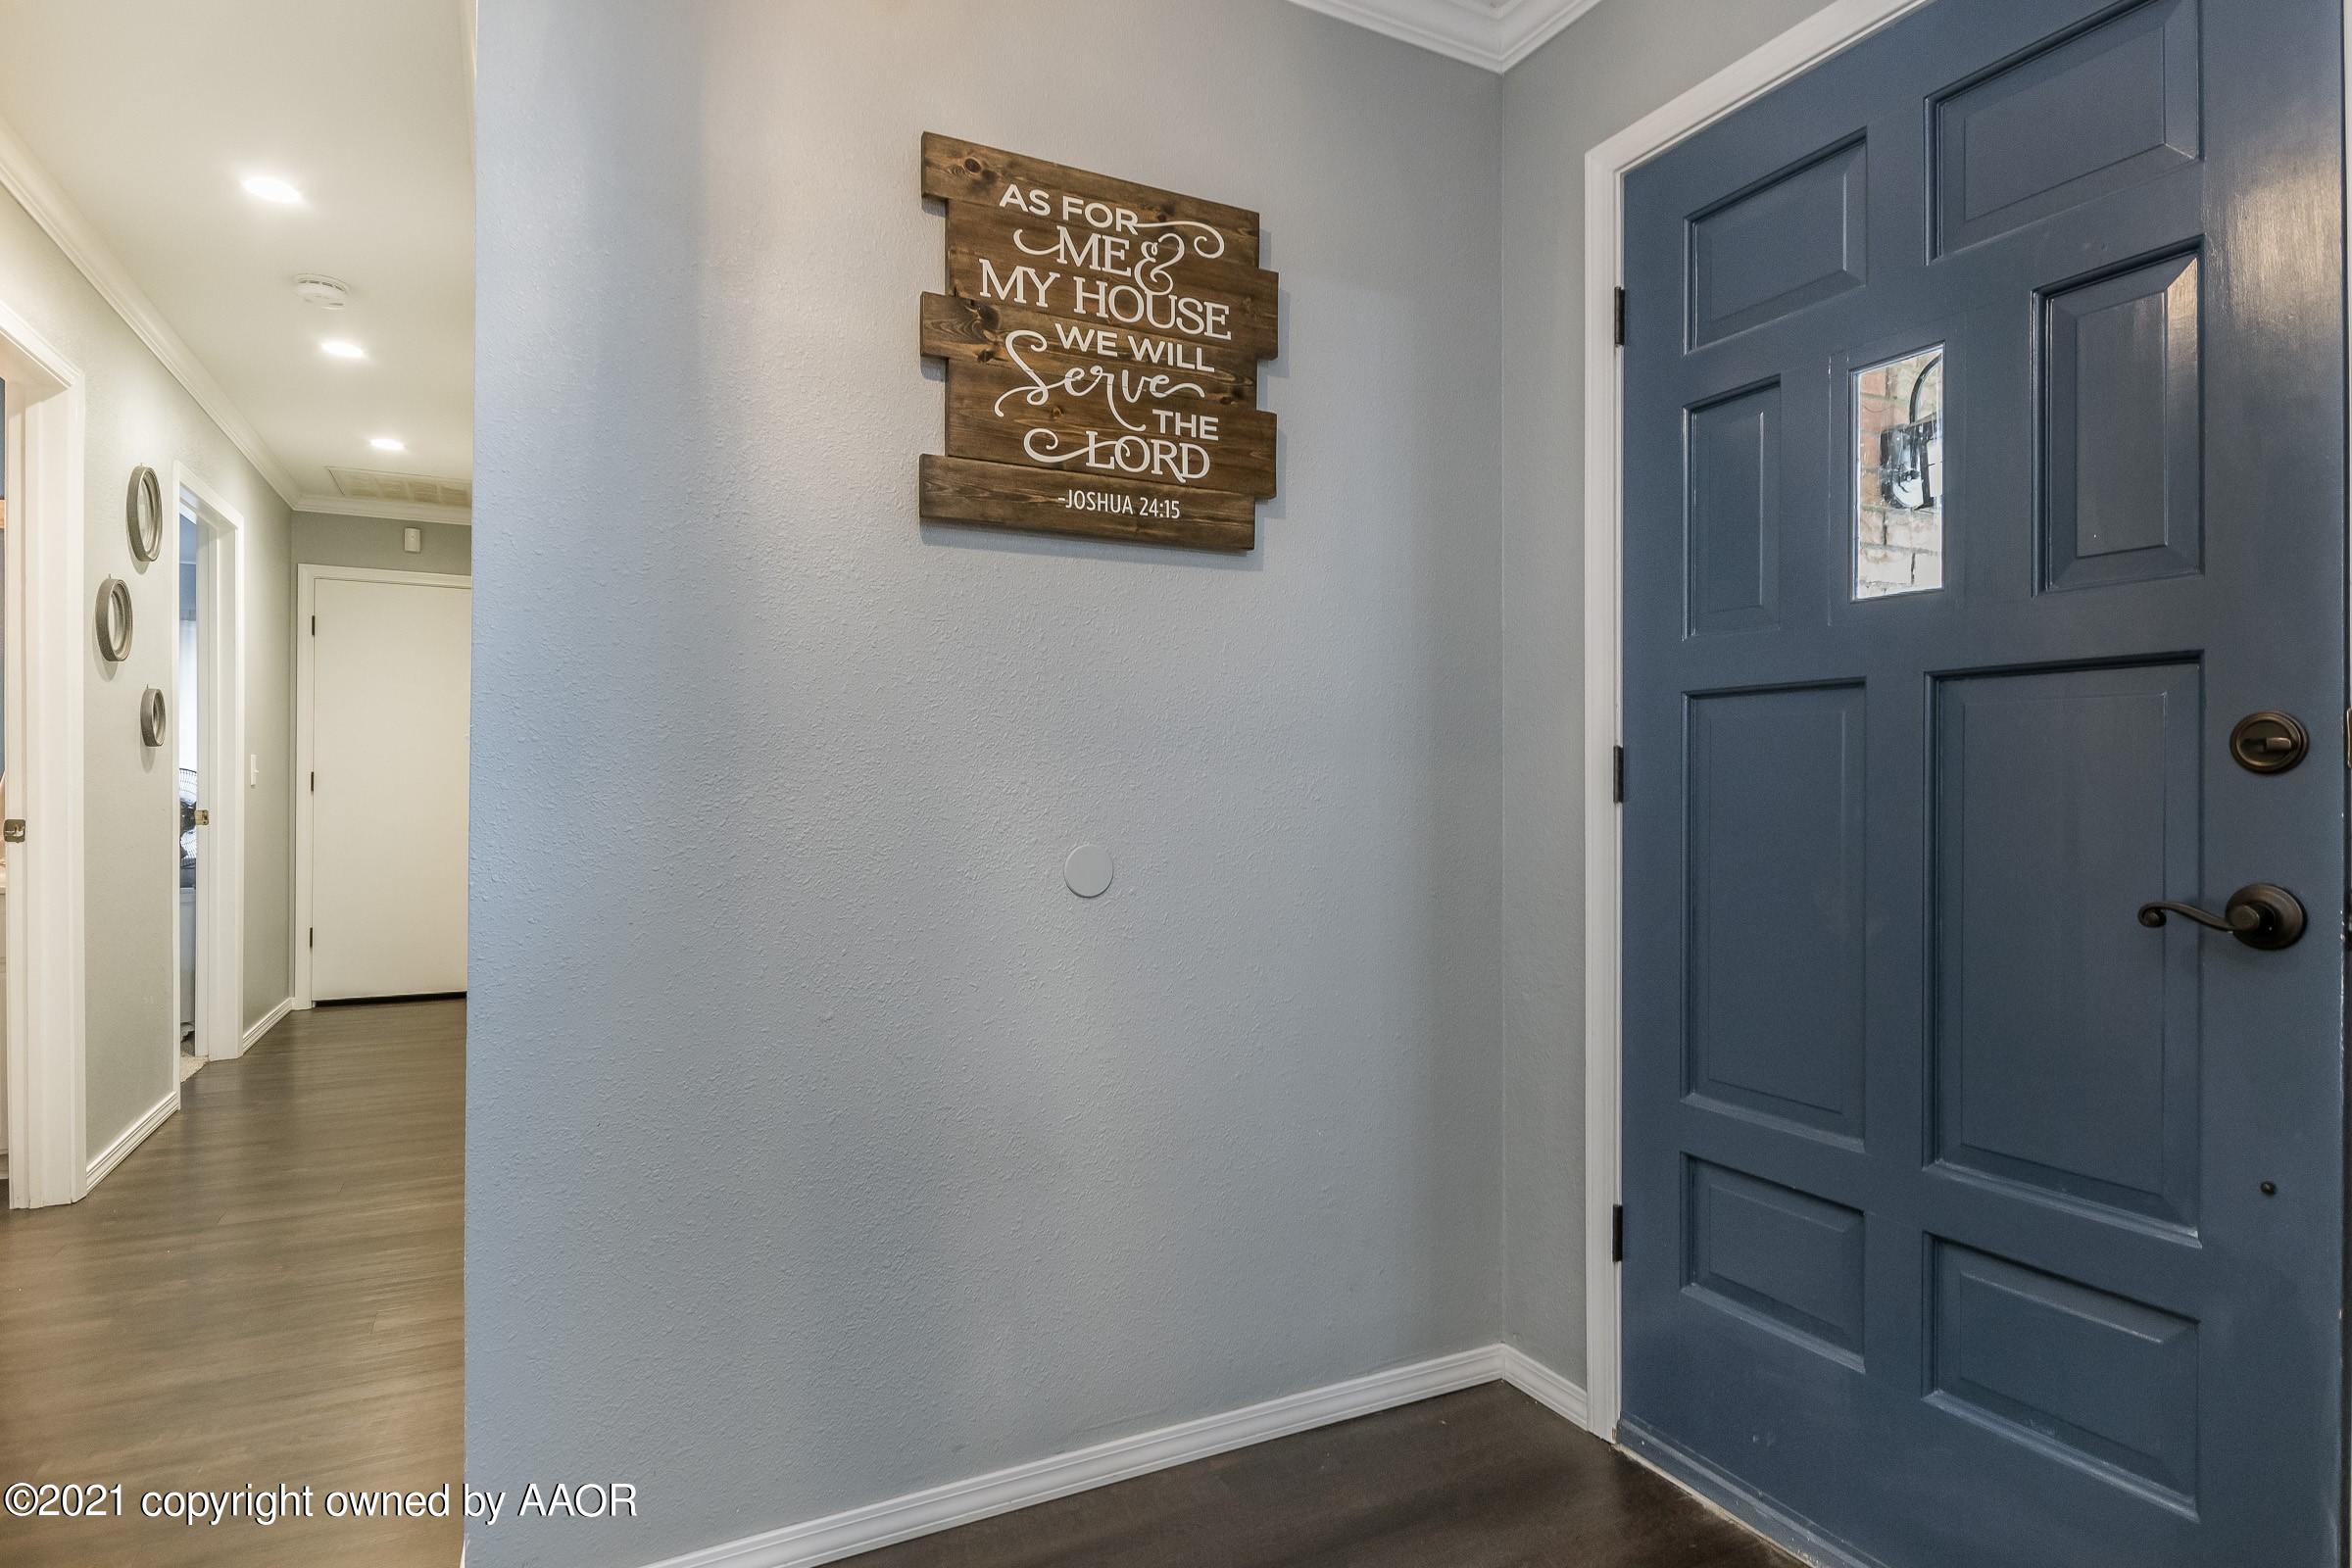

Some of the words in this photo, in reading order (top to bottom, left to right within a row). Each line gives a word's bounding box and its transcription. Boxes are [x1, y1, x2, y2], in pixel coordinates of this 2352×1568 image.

[999, 184, 1052, 217] AS
[1055, 224, 1133, 278] ME
[1134, 232, 1185, 295] &
[978, 258, 1060, 308] MY
[1073, 275, 1232, 340] HOUSE
[1054, 322, 1118, 358] WE
[1128, 335, 1215, 373] WILL
[994, 328, 1205, 432] Serve
[1152, 408, 1219, 441] THE
[1085, 428, 1210, 483] LORD
[1140, 497, 1181, 519] 24:15
